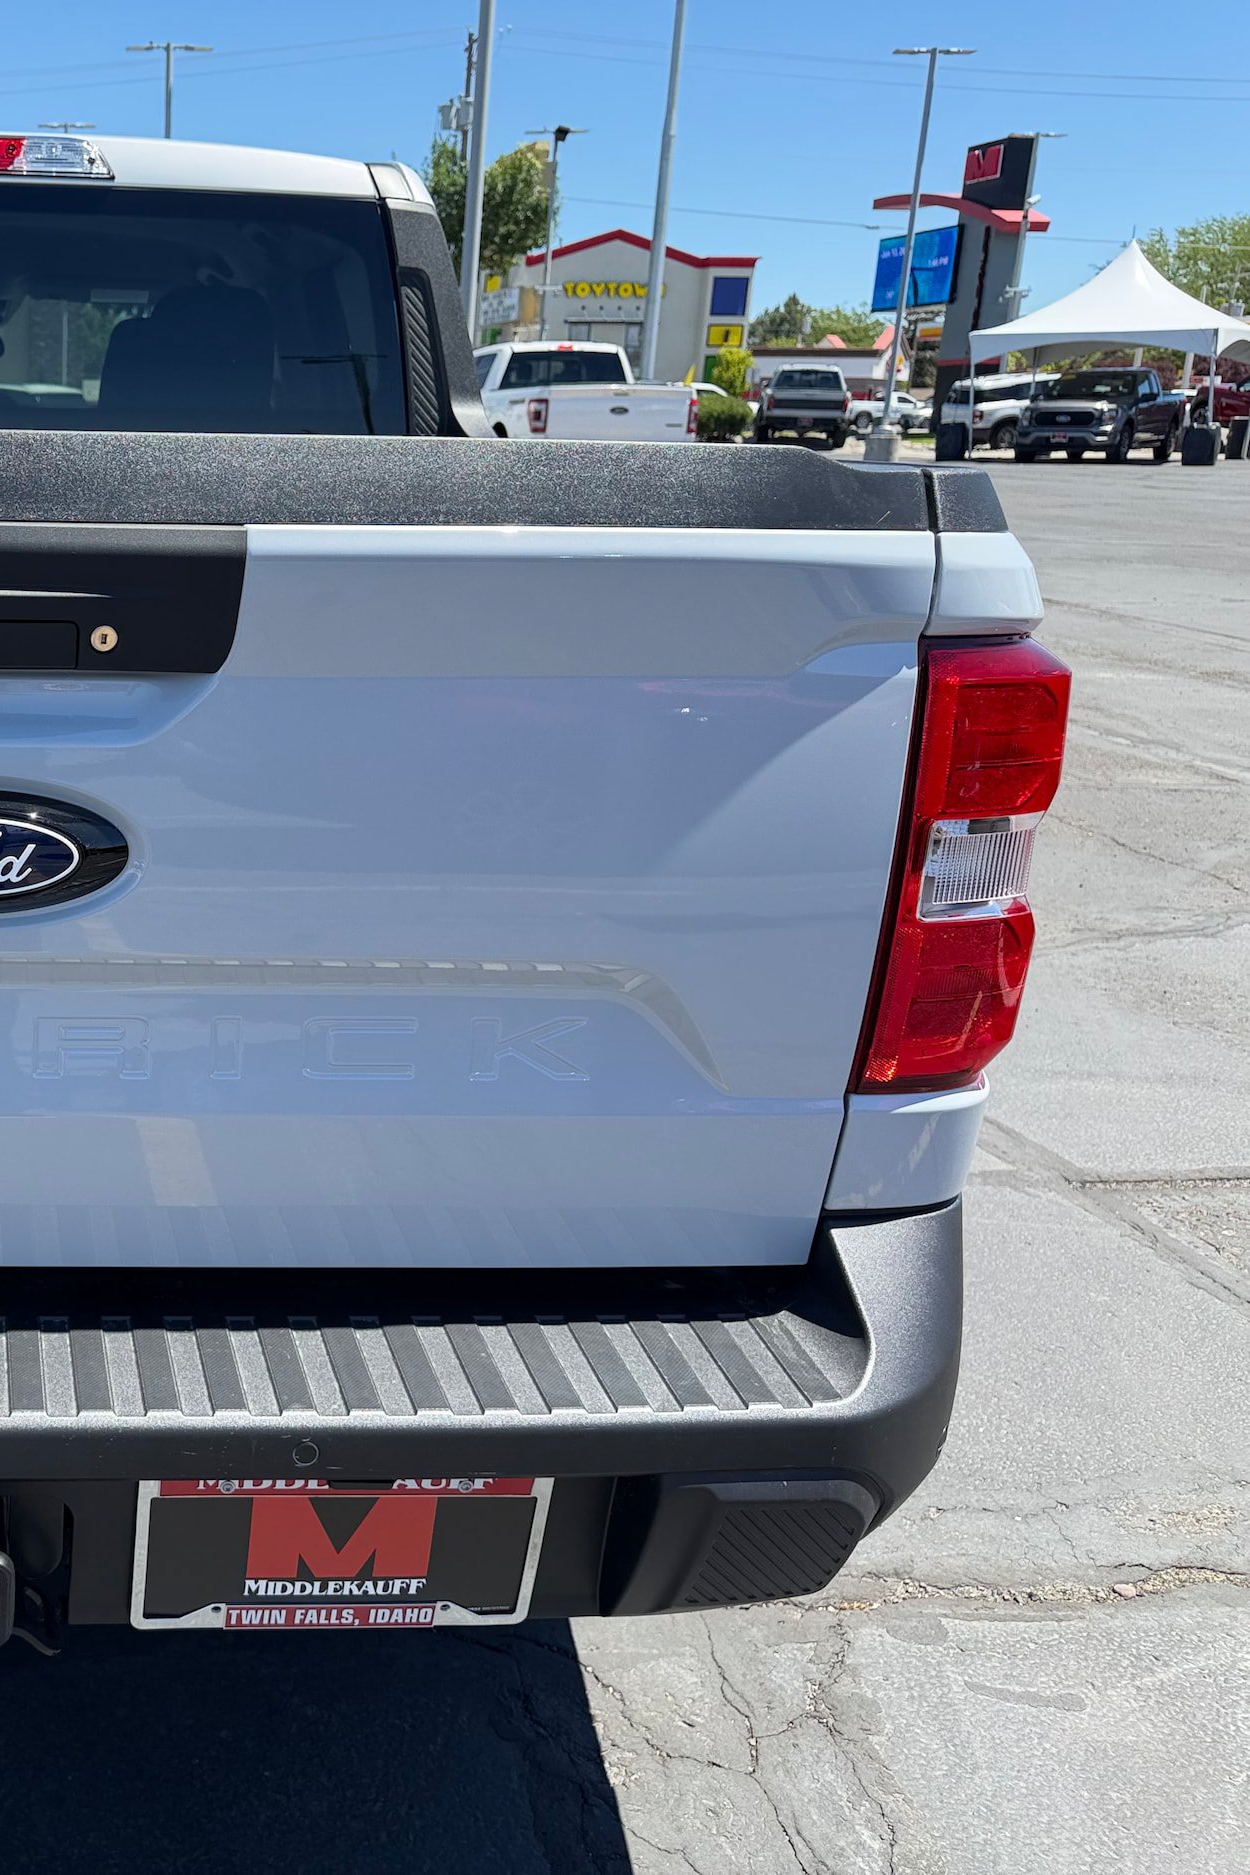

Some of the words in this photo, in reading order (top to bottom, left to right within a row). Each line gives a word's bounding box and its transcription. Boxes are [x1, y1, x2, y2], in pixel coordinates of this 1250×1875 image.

[563, 281, 667, 299] TOYTOW
[243, 1579, 426, 1596] MIDDLEKAUFF
[228, 1609, 287, 1625] TWIN
[293, 1608, 360, 1626] FALLS,
[368, 1607, 433, 1624] IDAHO
